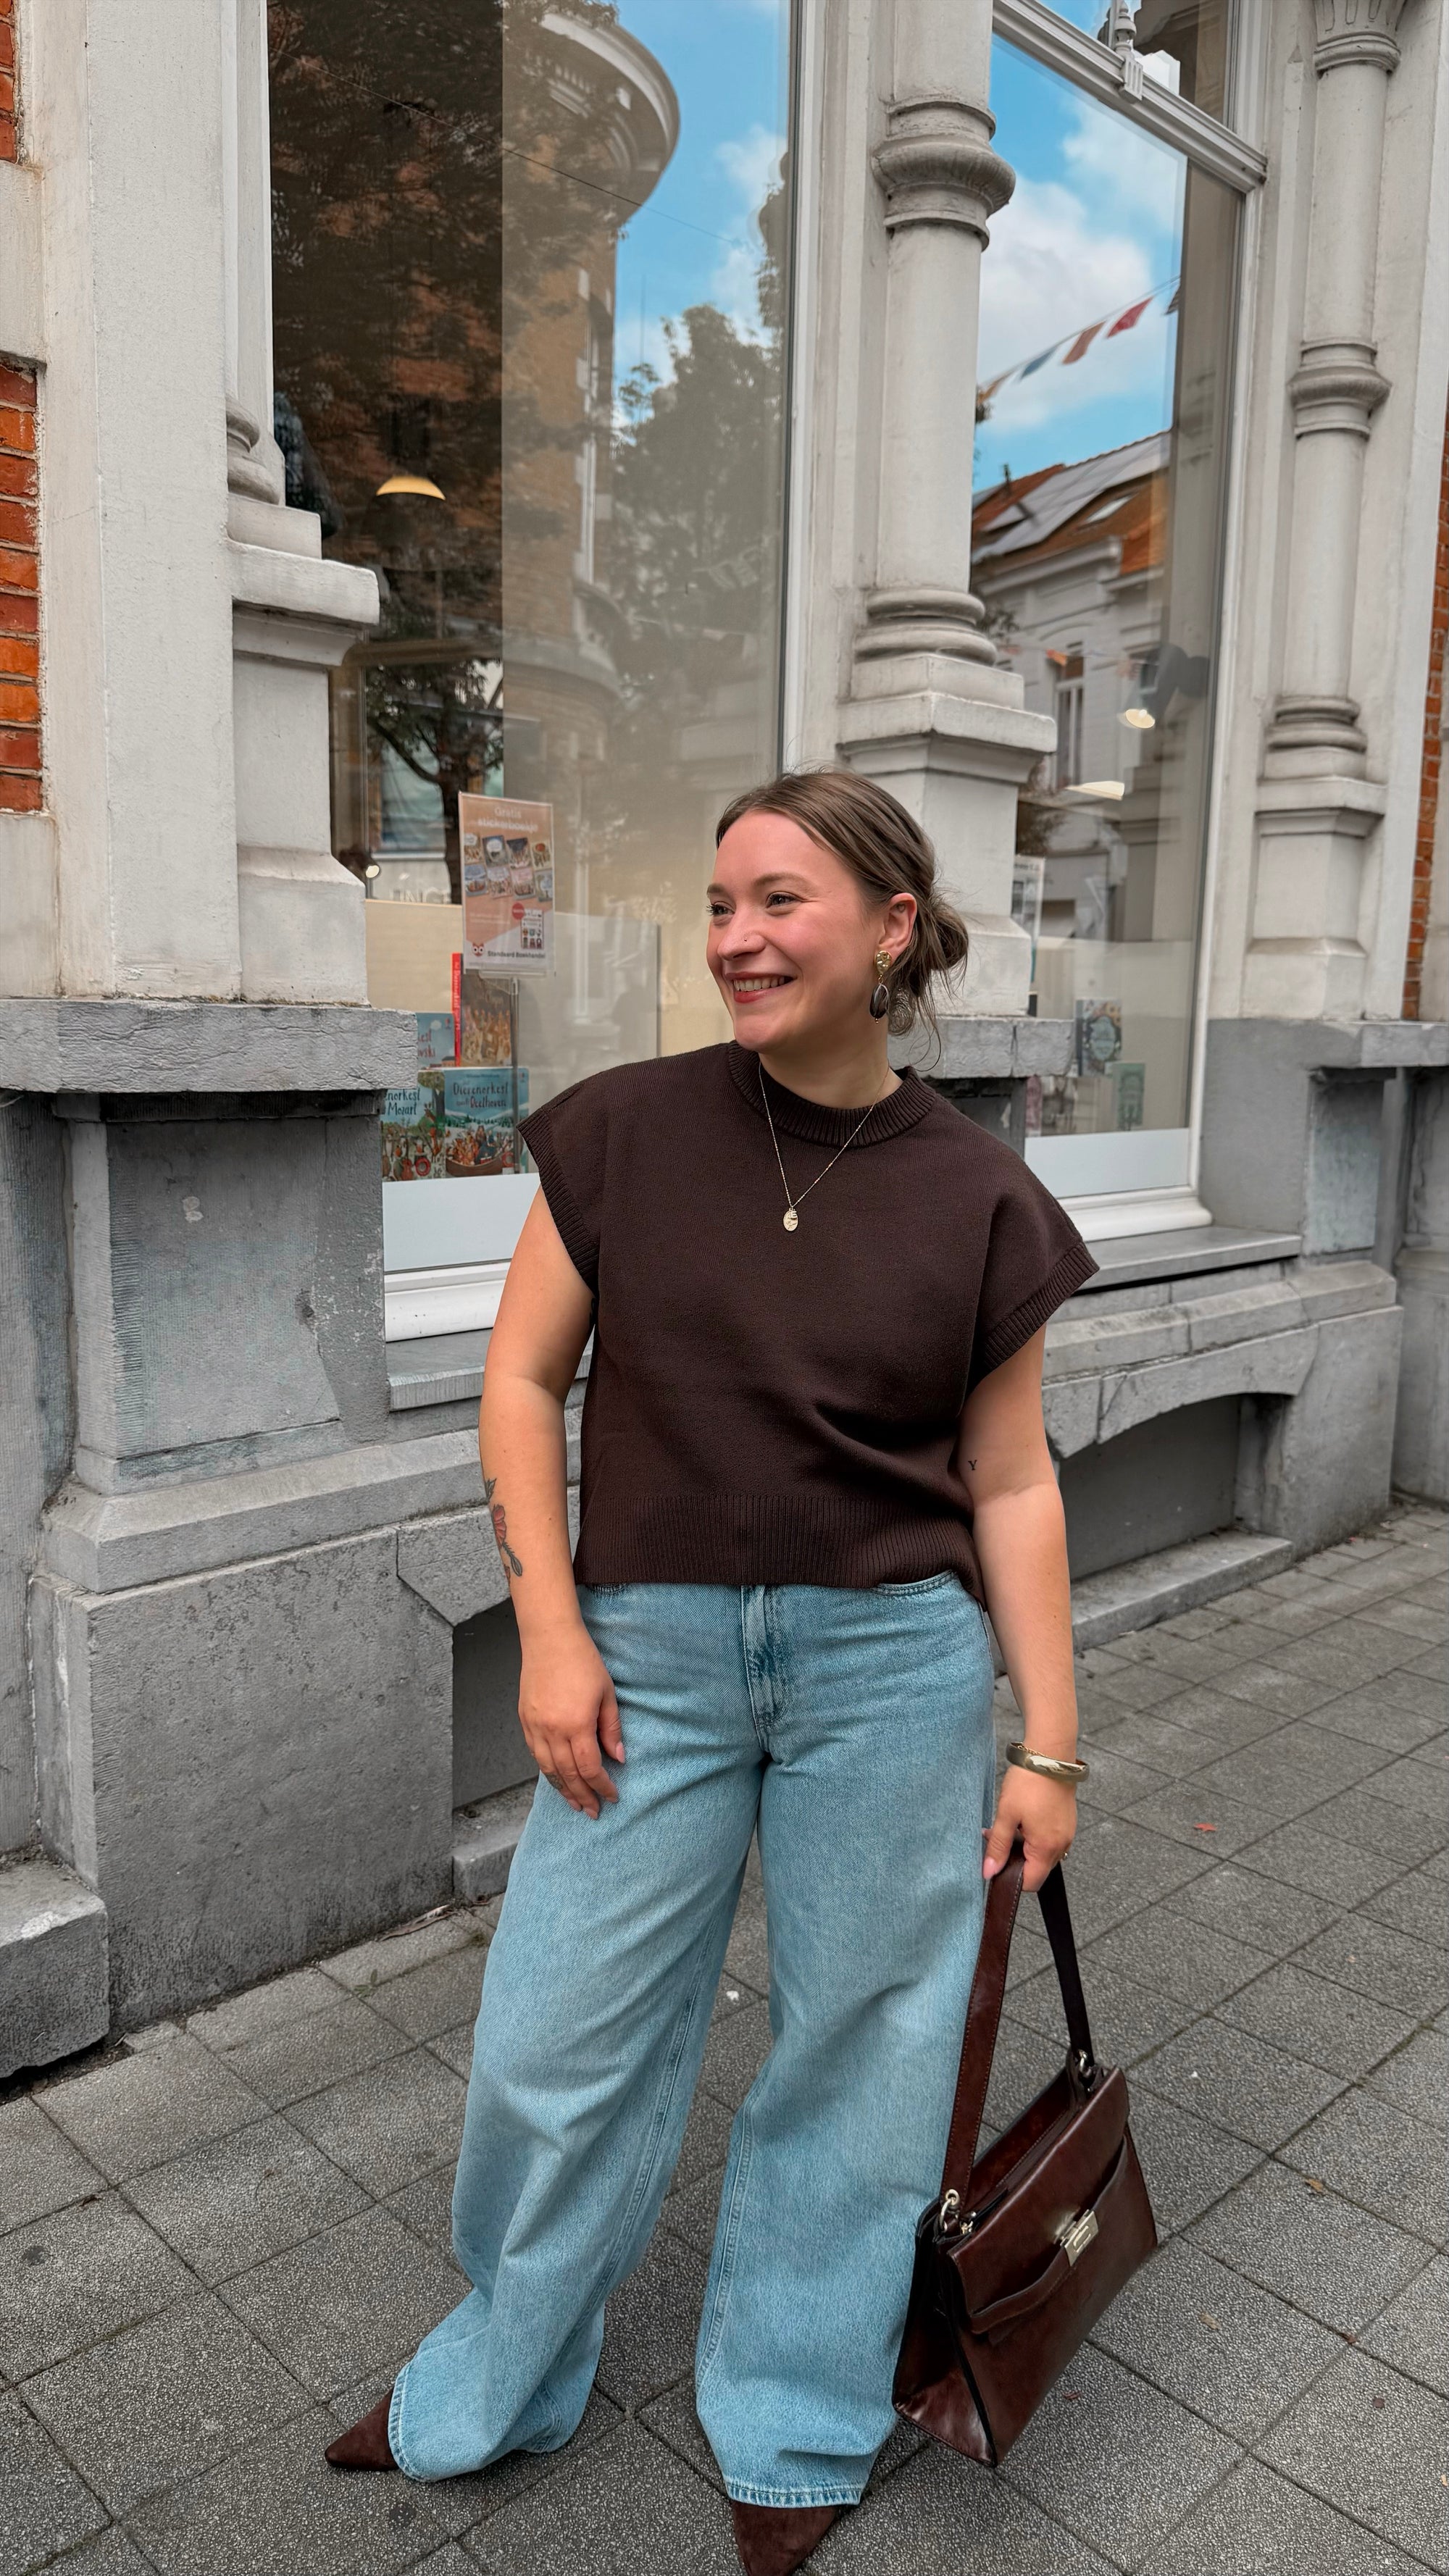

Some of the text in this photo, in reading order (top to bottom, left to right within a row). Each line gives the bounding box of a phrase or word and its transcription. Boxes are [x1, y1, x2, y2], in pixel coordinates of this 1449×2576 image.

[453, 1082, 509, 1095] Dierenorkest
[470, 1095, 507, 1108] Beethoven
[388, 1101, 417, 1116] Mozart
[967, 1459, 978, 1471] Y
